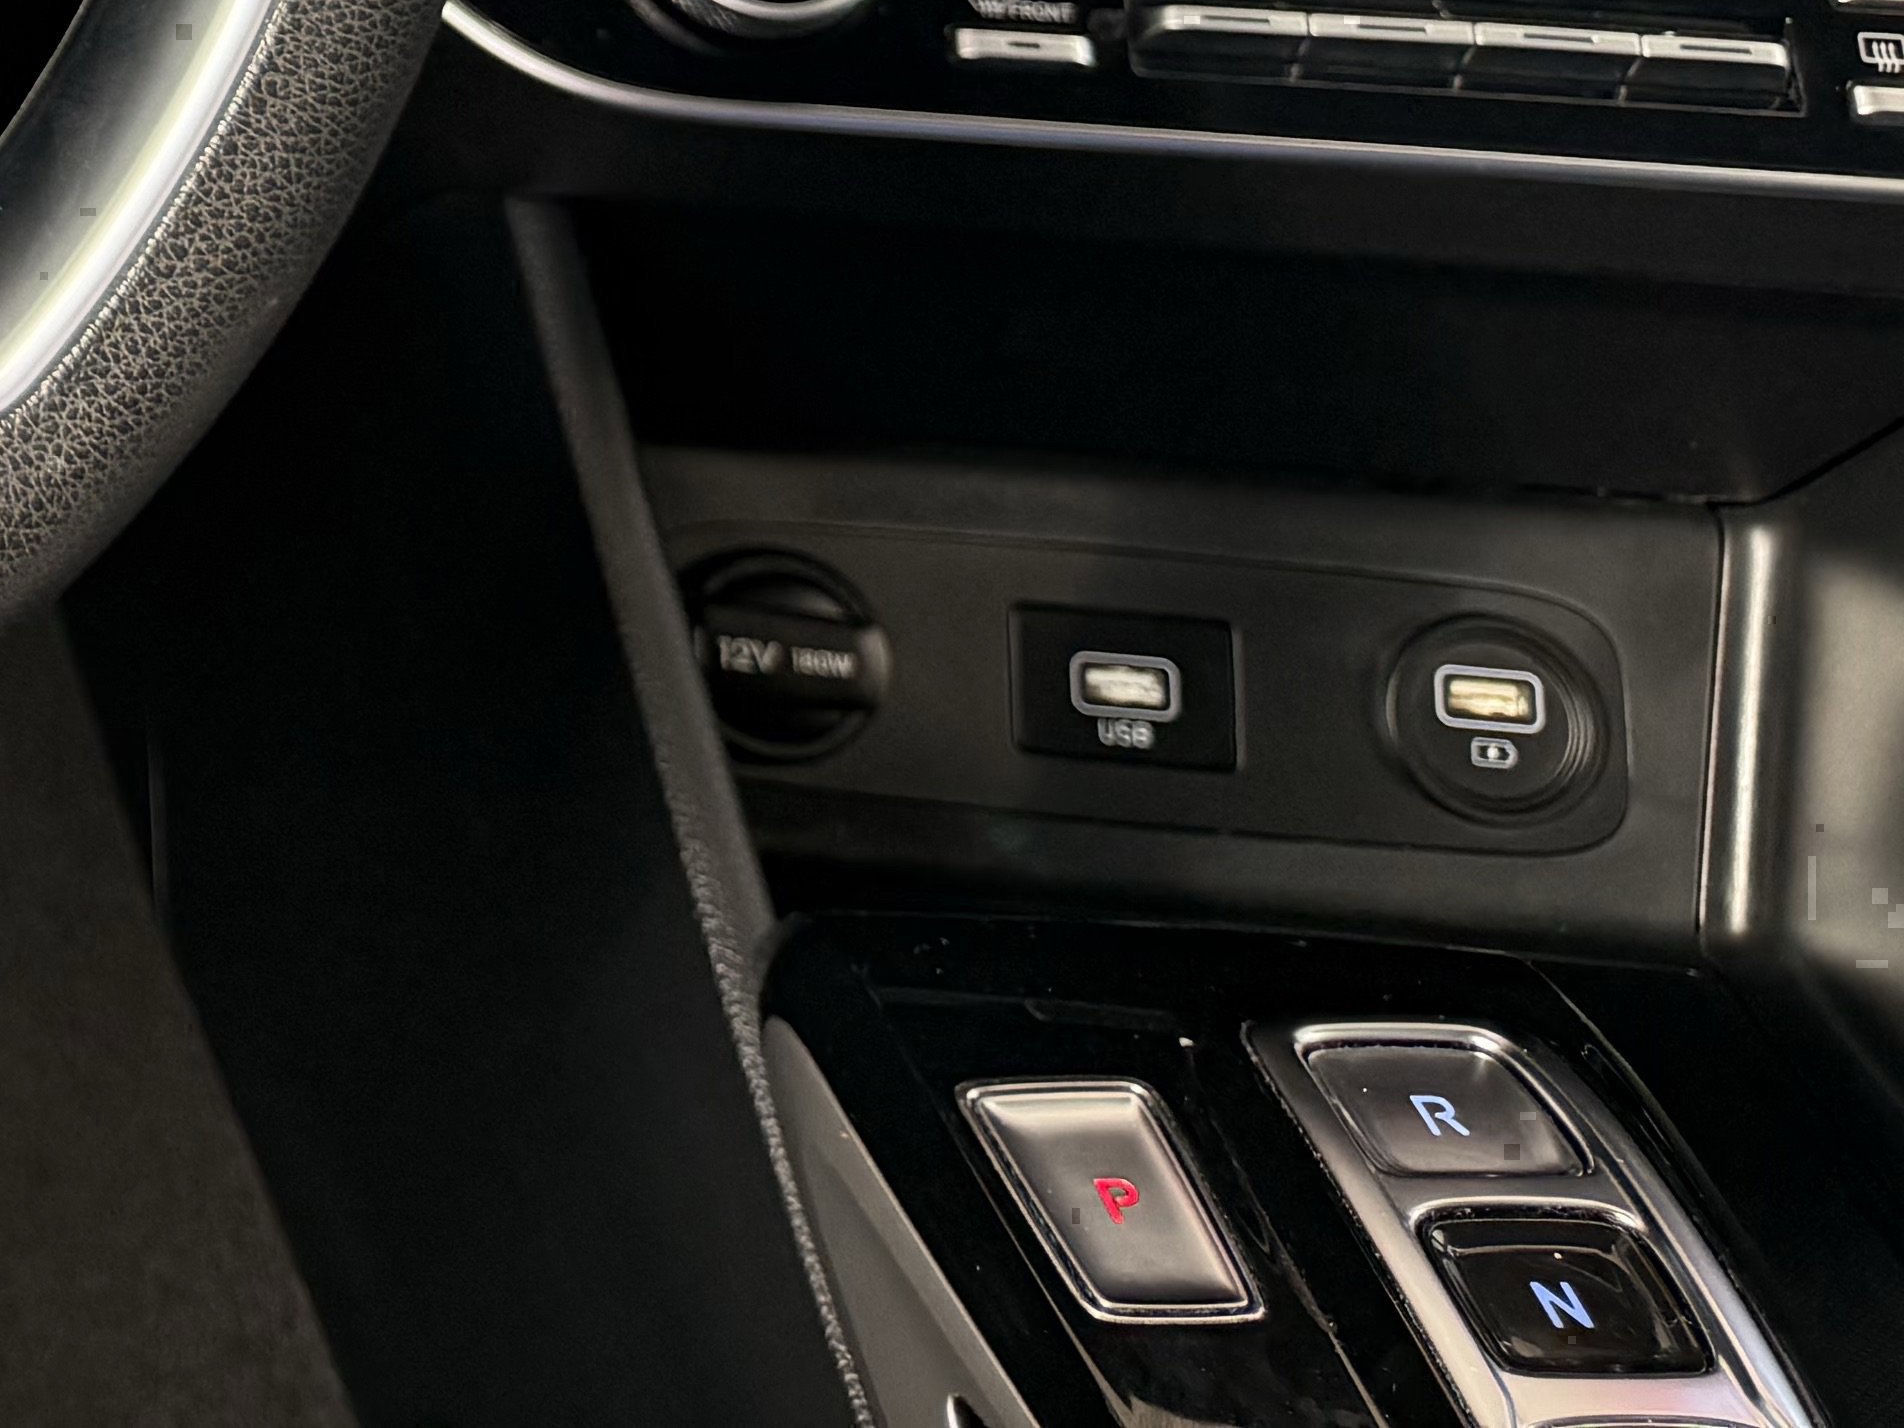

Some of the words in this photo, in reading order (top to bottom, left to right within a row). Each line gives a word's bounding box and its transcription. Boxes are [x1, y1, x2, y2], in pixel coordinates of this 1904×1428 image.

[719, 635, 784, 675] 12V
[1097, 718, 1154, 749] USB
[1409, 1094, 1471, 1137] R
[1093, 1178, 1140, 1225] P
[1529, 1280, 1595, 1329] N
